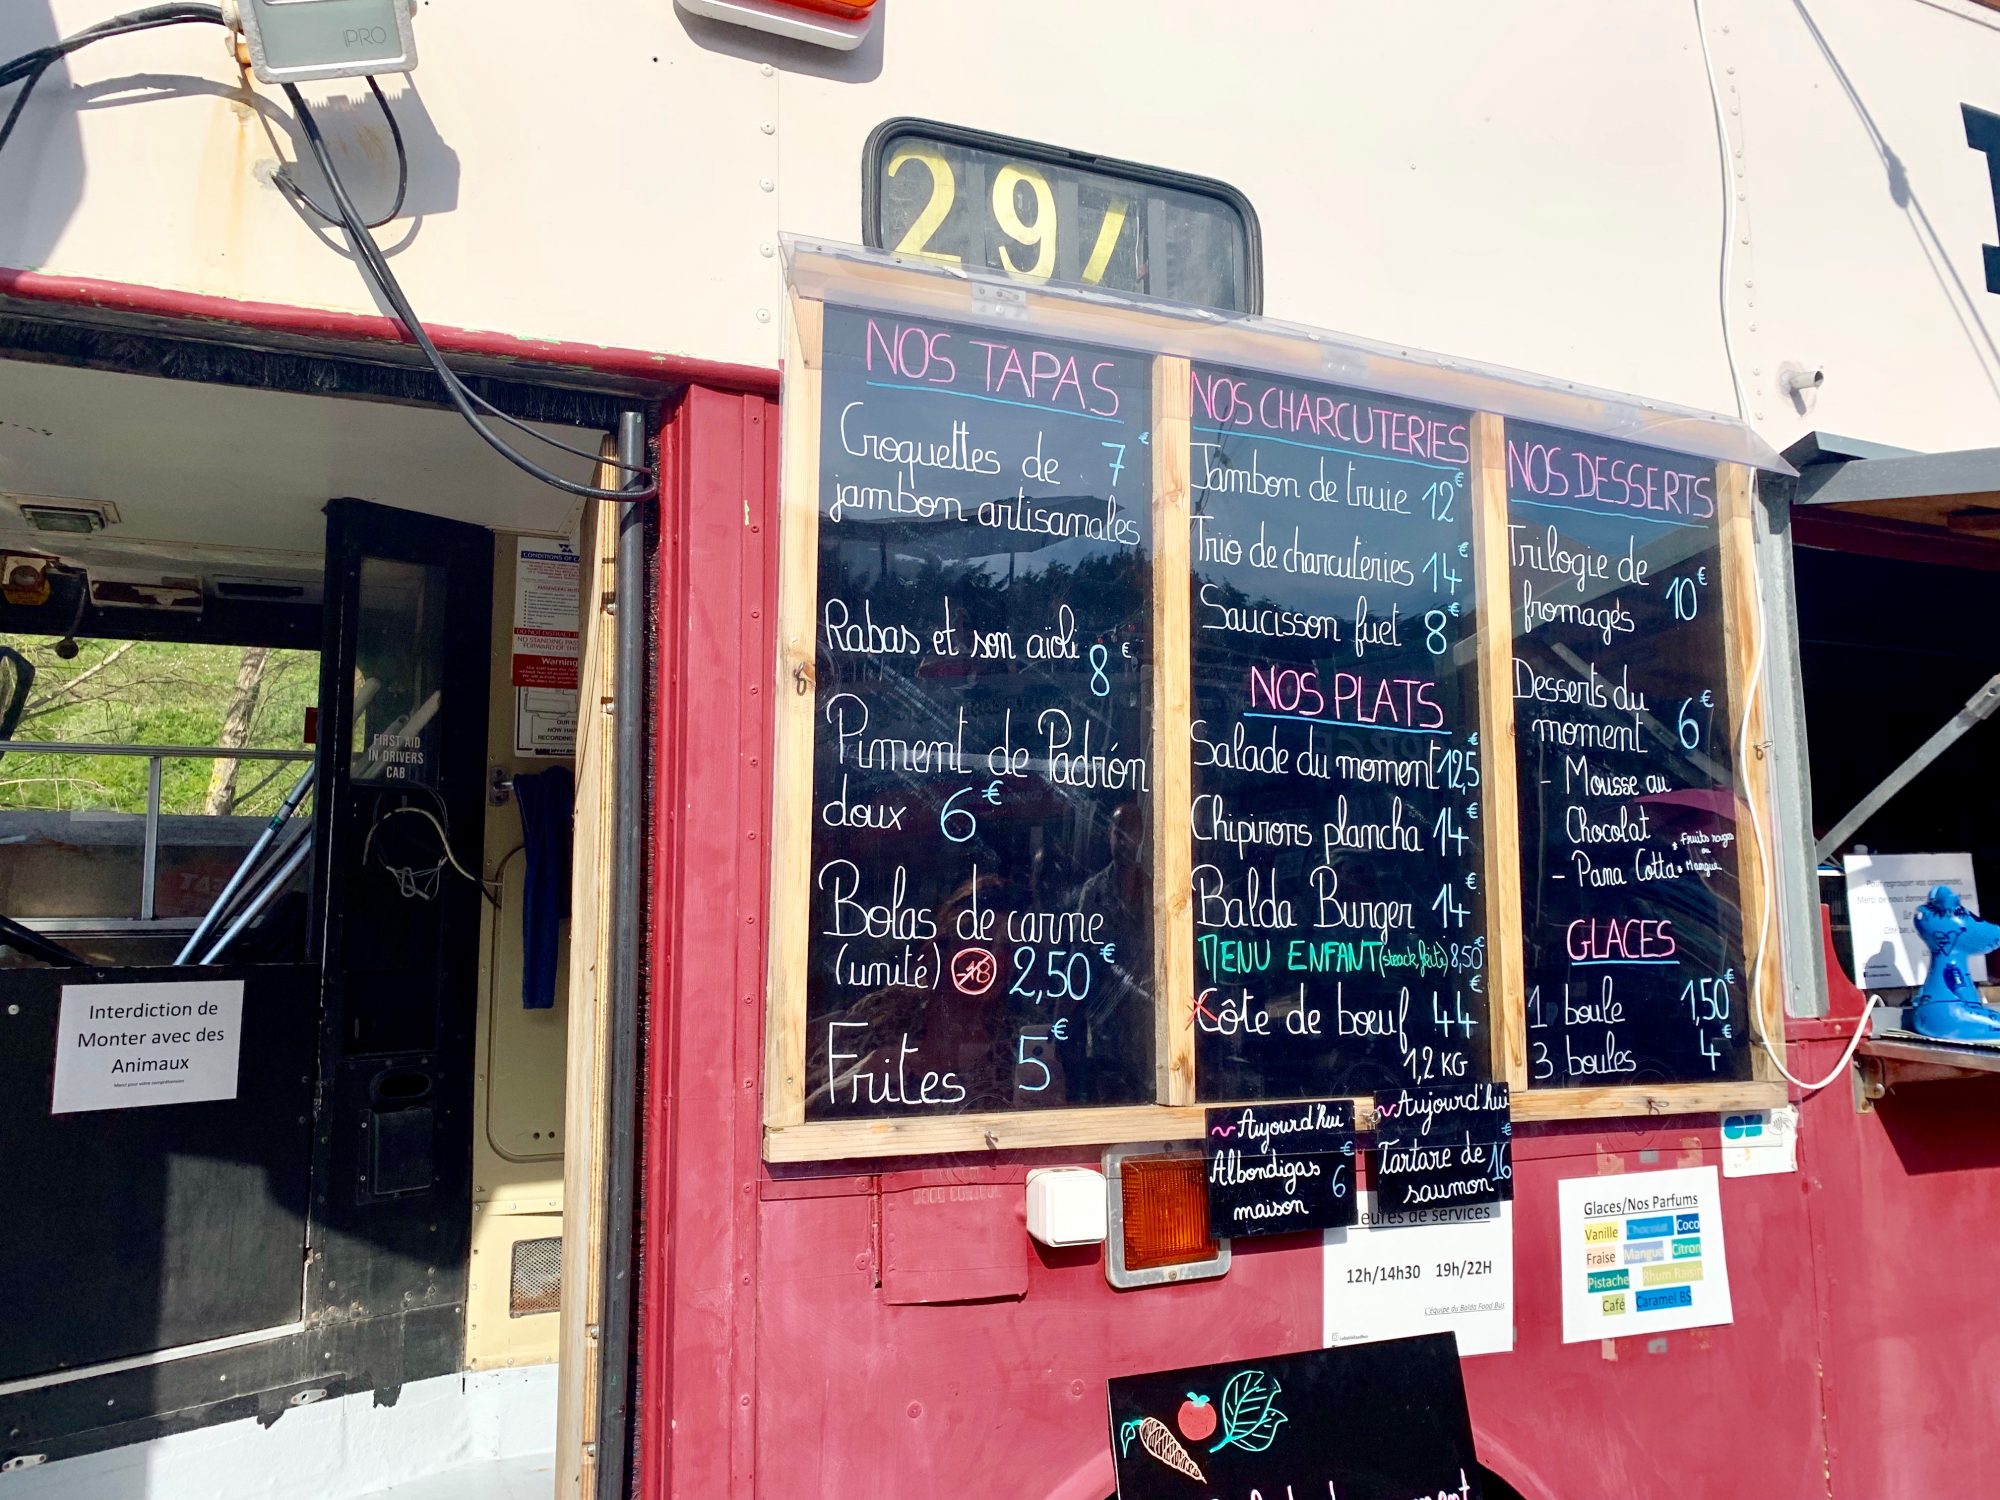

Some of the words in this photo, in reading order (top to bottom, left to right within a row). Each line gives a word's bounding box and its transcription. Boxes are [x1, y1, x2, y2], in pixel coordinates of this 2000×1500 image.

[343, 26, 386, 47] PRO
[867, 319, 956, 383] NOS
[969, 340, 1119, 416] TAPAS
[1190, 371, 1253, 425] NOS
[1260, 387, 1469, 464] CHARCUTERIES
[840, 401, 1001, 489] Croquettes
[1022, 431, 1061, 485] de
[1190, 443, 1301, 498] Jambon
[1309, 456, 1338, 502] de
[1347, 461, 1411, 514] truie
[1508, 440, 1569, 497] NOS
[1571, 452, 1714, 518] DESSERTS
[830, 471, 968, 523] jambon
[977, 487, 1141, 546] artisanales
[1190, 515, 1242, 565] Trio
[1250, 521, 1278, 569] de
[1283, 525, 1414, 586] charcuteries
[1508, 525, 1609, 592] Trilogie
[1618, 535, 1649, 586] de
[825, 597, 920, 655] Rabas
[933, 596, 959, 656] et
[970, 627, 1017, 660] son
[1026, 604, 1080, 660] aïoli
[1200, 584, 1341, 642] Saucisson
[1355, 595, 1402, 657] fuet
[541, 657, 578, 666] Warning
[1512, 657, 1607, 708] Desserts
[1614, 664, 1649, 711] du
[1251, 665, 1325, 716] NOS
[1334, 673, 1443, 728] PLATS
[373, 734, 400, 747] FIRST
[404, 736, 420, 748] AID
[826, 693, 972, 774] Piment
[988, 708, 1029, 777] de
[1038, 708, 1150, 792] Padrón
[1190, 720, 1289, 774] Salade
[1297, 725, 1330, 779] du
[1336, 740, 1440, 790] moment
[1532, 713, 1648, 753] moment
[368, 749, 378, 761] IN
[383, 750, 424, 764] DRIVERS
[386, 766, 405, 778] CAB
[1566, 755, 1639, 797] Mousse
[1646, 775, 1672, 794] au
[823, 774, 907, 830] doux
[1566, 805, 1651, 843] Chocolat
[1191, 795, 1312, 860] Chipirons
[1325, 794, 1424, 864] plancha
[1571, 850, 1627, 888] Pana
[1635, 848, 1679, 882] Cotta
[819, 859, 937, 940] Bolas
[956, 863, 994, 941] de
[1007, 911, 1104, 945] carne
[1192, 864, 1297, 928] Balda
[1310, 865, 1415, 942] Burger
[1198, 934, 1271, 983] MENU
[1287, 940, 1383, 973] ENFANT
[1567, 919, 1676, 960] GLACES
[836, 942, 941, 991] (unité)
[90, 1003, 192, 1020] Interdiction
[198, 1001, 218, 1016] de
[1198, 987, 1271, 1035] Côte
[1286, 983, 1321, 1035] de
[1528, 985, 1548, 1028] 1
[1565, 975, 1626, 1025] boule
[78, 1032, 146, 1048] Monter
[152, 1031, 191, 1044] avec
[196, 1027, 224, 1043] des
[1533, 1042, 1553, 1079] 3
[1567, 1031, 1637, 1075] boules
[112, 1058, 189, 1074] Animaux
[828, 1022, 966, 1104] Frites
[1441, 1051, 1468, 1076] KG
[1394, 1084, 1508, 1135] Aujourd'hui
[1210, 1149, 1321, 1194] Albondigas
[1379, 1139, 1452, 1175] Tartare
[1461, 1131, 1486, 1163] de
[1234, 1199, 1309, 1221] maison
[1403, 1177, 1494, 1204] saumon
[1653, 1194, 1698, 1208] Parfums
[1361, 1212, 1404, 1225] eures
[1432, 1207, 1490, 1221] services
[1585, 1226, 1618, 1241] Vanille
[1676, 1220, 1699, 1231] Coco
[1347, 1264, 1421, 1285] 12h/14h30
[1435, 1260, 1492, 1279] 19h/22H
[1587, 1251, 1615, 1265] Fraise
[1672, 1244, 1701, 1255] Citron
[1588, 1275, 1629, 1289] Pistache
[1603, 1298, 1625, 1312] Café
[1636, 1293, 1676, 1308] Caramel
